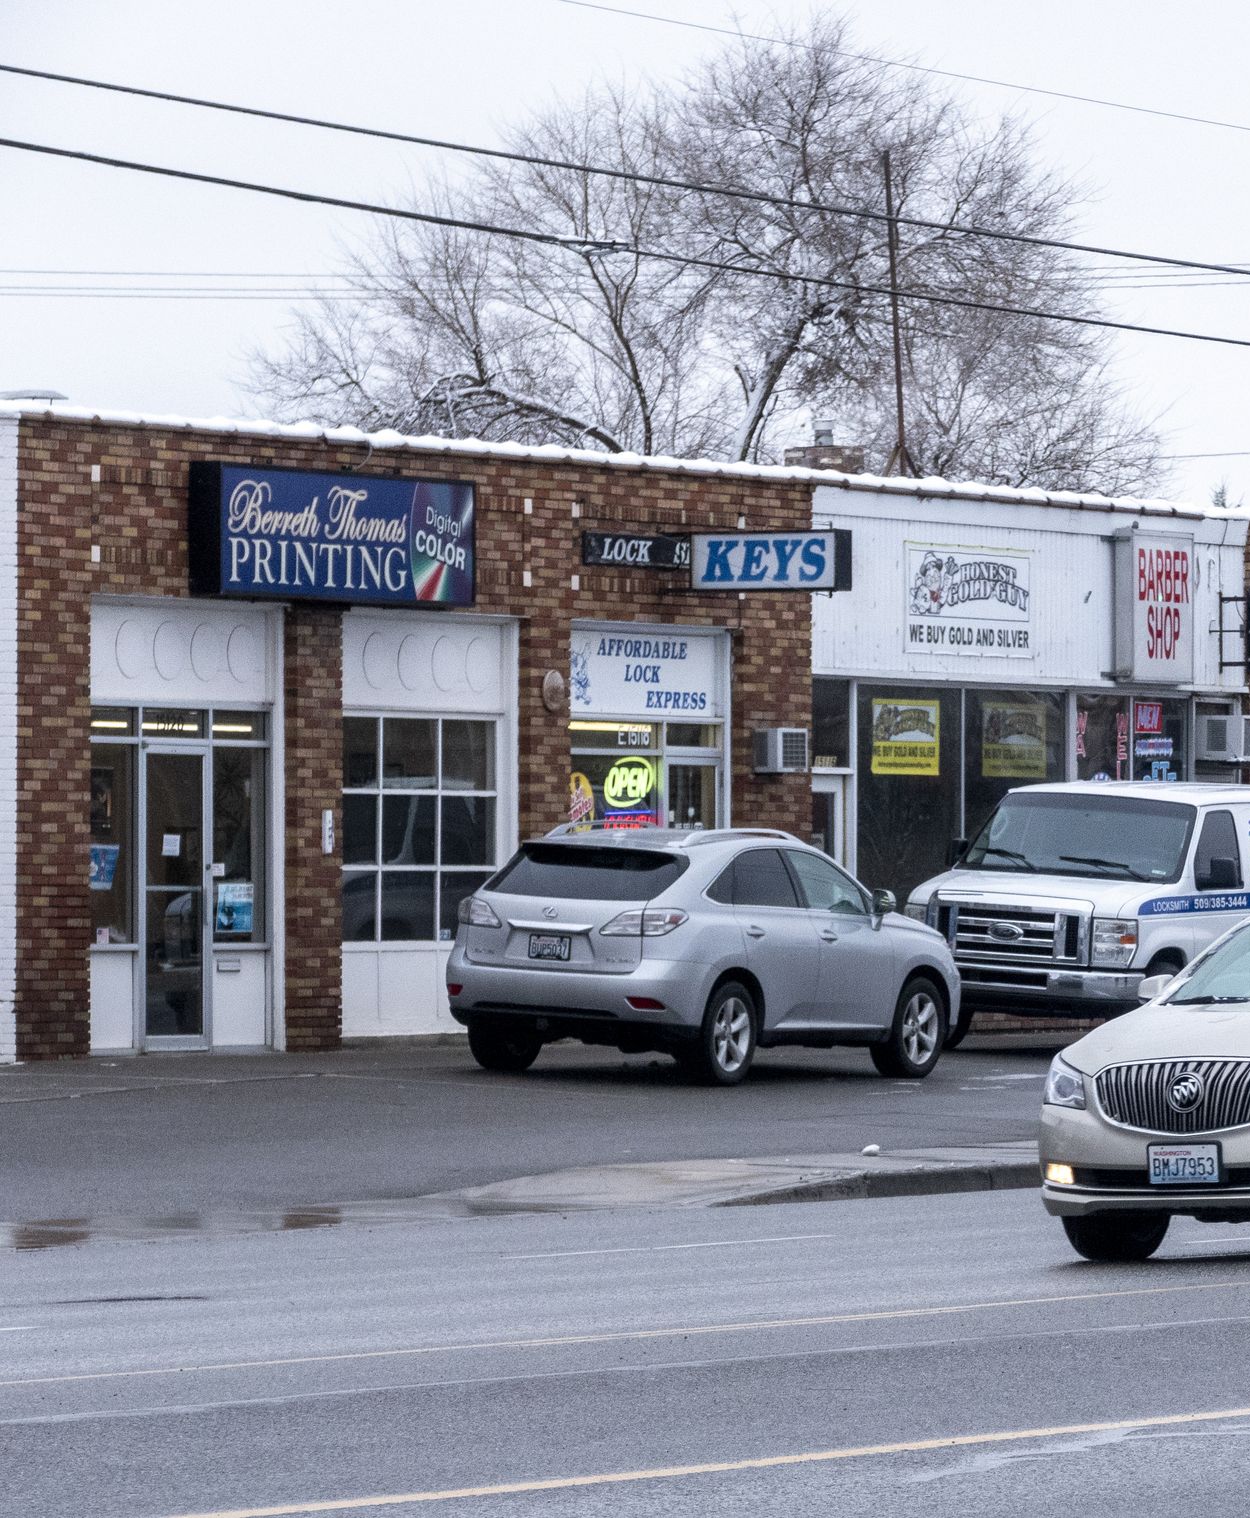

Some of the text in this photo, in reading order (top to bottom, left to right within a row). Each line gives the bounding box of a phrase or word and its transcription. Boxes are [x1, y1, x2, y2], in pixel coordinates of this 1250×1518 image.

[227, 480, 409, 543] Berreth Thomas
[426, 506, 463, 538] Digital
[228, 537, 408, 592] PRINTING
[415, 530, 466, 570] COLOR
[601, 537, 652, 562] LOCK
[702, 538, 826, 582] KEYS
[960, 561, 1017, 586] HONEST
[1138, 548, 1189, 603] BARBER
[947, 580, 1030, 612] GOLD GUY
[909, 624, 1029, 648] WE BUY GOLD AND SILVER
[1147, 605, 1180, 660] SHOP
[597, 638, 687, 660] AFFORDABLE
[624, 664, 661, 683] LOCK
[646, 690, 707, 710] EXPRESS
[607, 766, 649, 798] OPEN
[1153, 895, 1247, 912] LOCKSMITH 509/385-3444
[1153, 1157, 1214, 1177] BMJ7953
